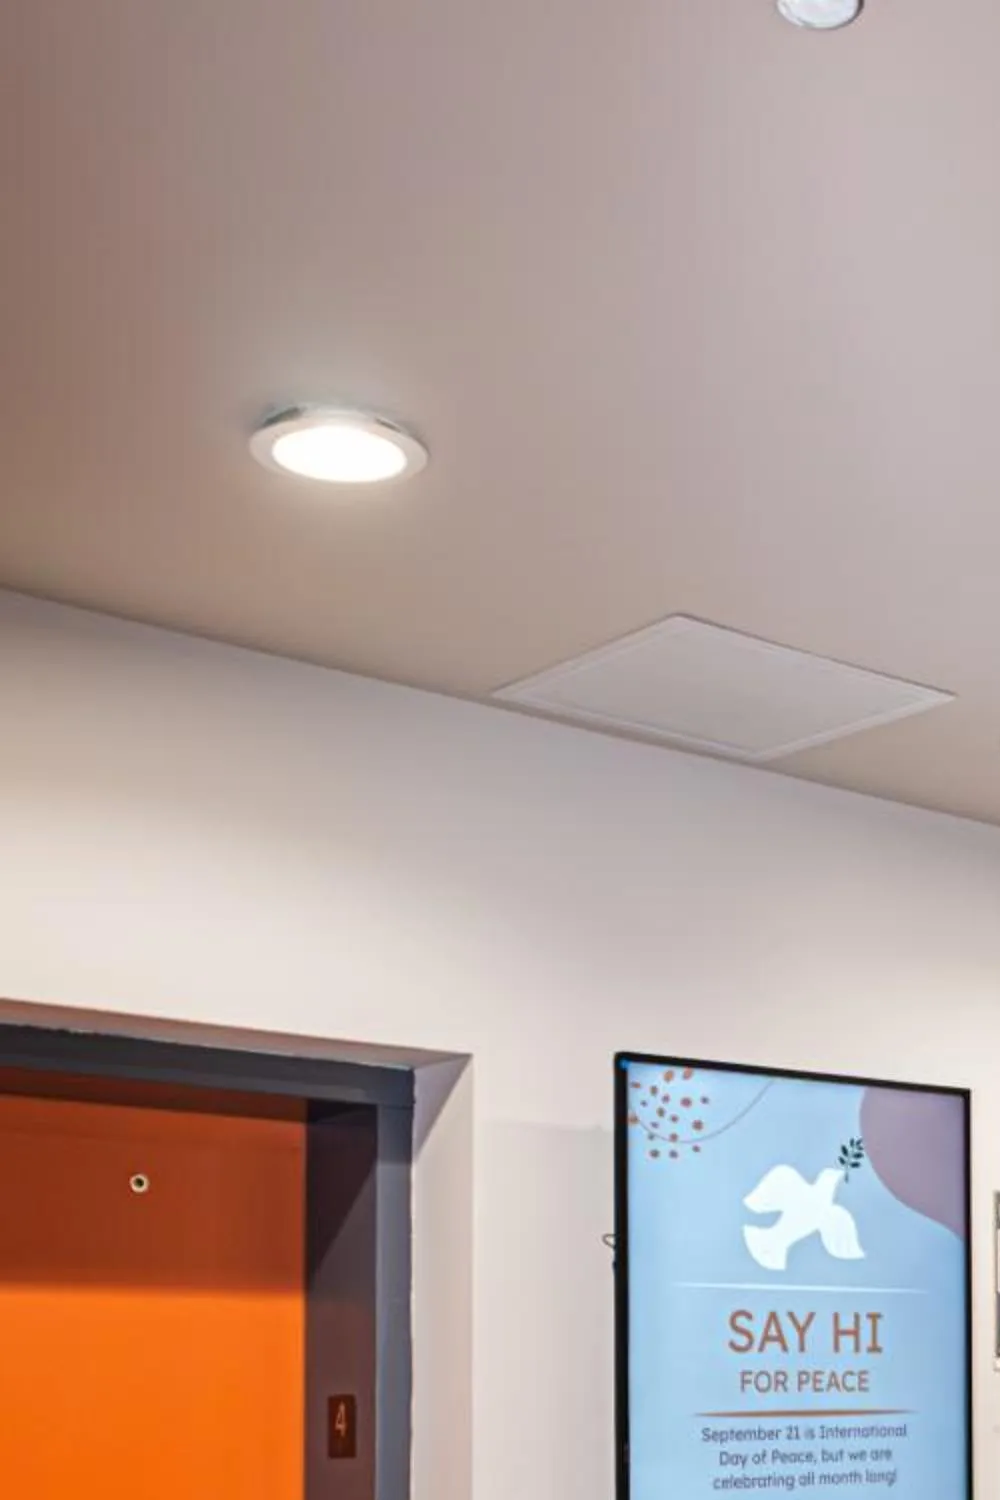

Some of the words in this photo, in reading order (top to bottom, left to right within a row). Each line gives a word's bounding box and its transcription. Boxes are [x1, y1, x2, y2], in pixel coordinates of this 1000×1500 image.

[729, 1310, 815, 1353] SAY
[833, 1312, 884, 1353] HI
[740, 1371, 788, 1393] FOR
[797, 1370, 870, 1392] PEACE
[335, 1401, 346, 1437] 4
[701, 1426, 782, 1444] September
[786, 1426, 800, 1440] 21
[804, 1426, 816, 1440] is
[820, 1424, 907, 1440] International
[719, 1451, 747, 1468] Day
[752, 1450, 768, 1465] of
[771, 1449, 817, 1465] Peace,
[821, 1449, 844, 1463] but
[849, 1450, 867, 1462] we
[870, 1448, 892, 1461] are
[713, 1474, 795, 1491] celebrating
[800, 1472, 815, 1486] all
[819, 1471, 862, 1485] month
[865, 1469, 897, 1487] long!
